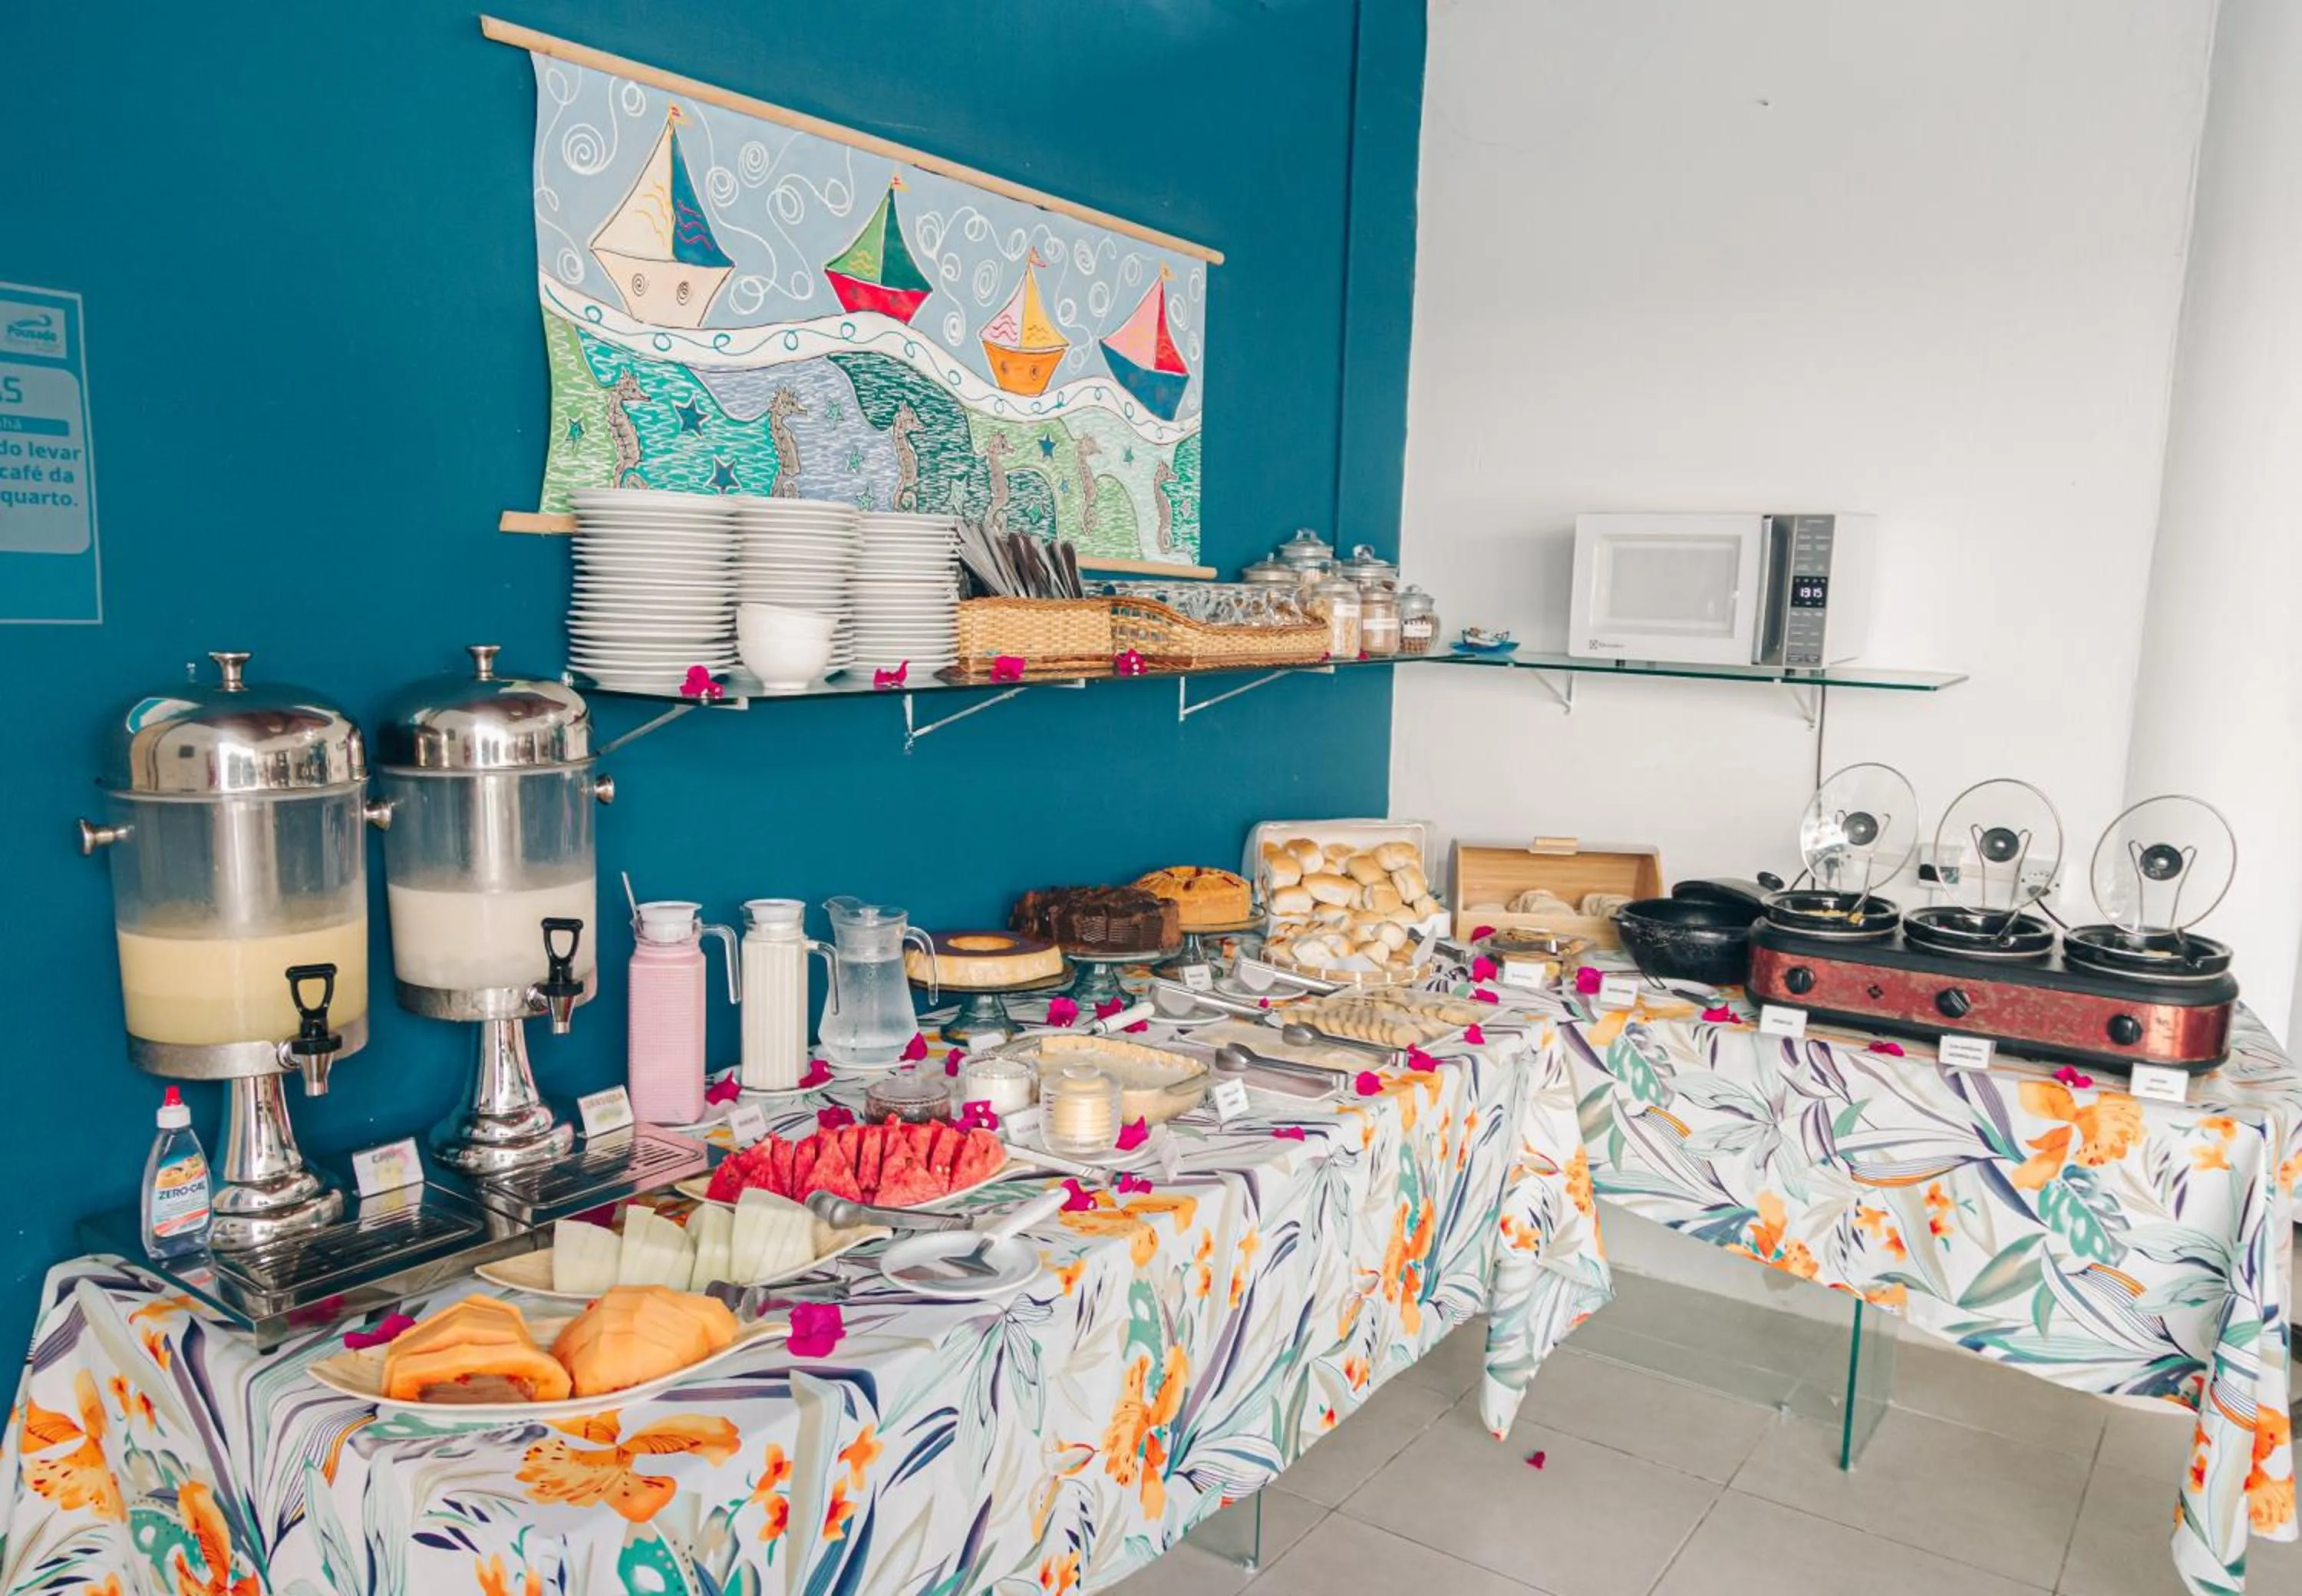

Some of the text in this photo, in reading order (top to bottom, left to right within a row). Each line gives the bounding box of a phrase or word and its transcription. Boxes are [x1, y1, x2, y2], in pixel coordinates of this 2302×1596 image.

[28, 441, 81, 460] levar
[0, 464, 74, 483] café da
[1, 491, 78, 507] quarto.
